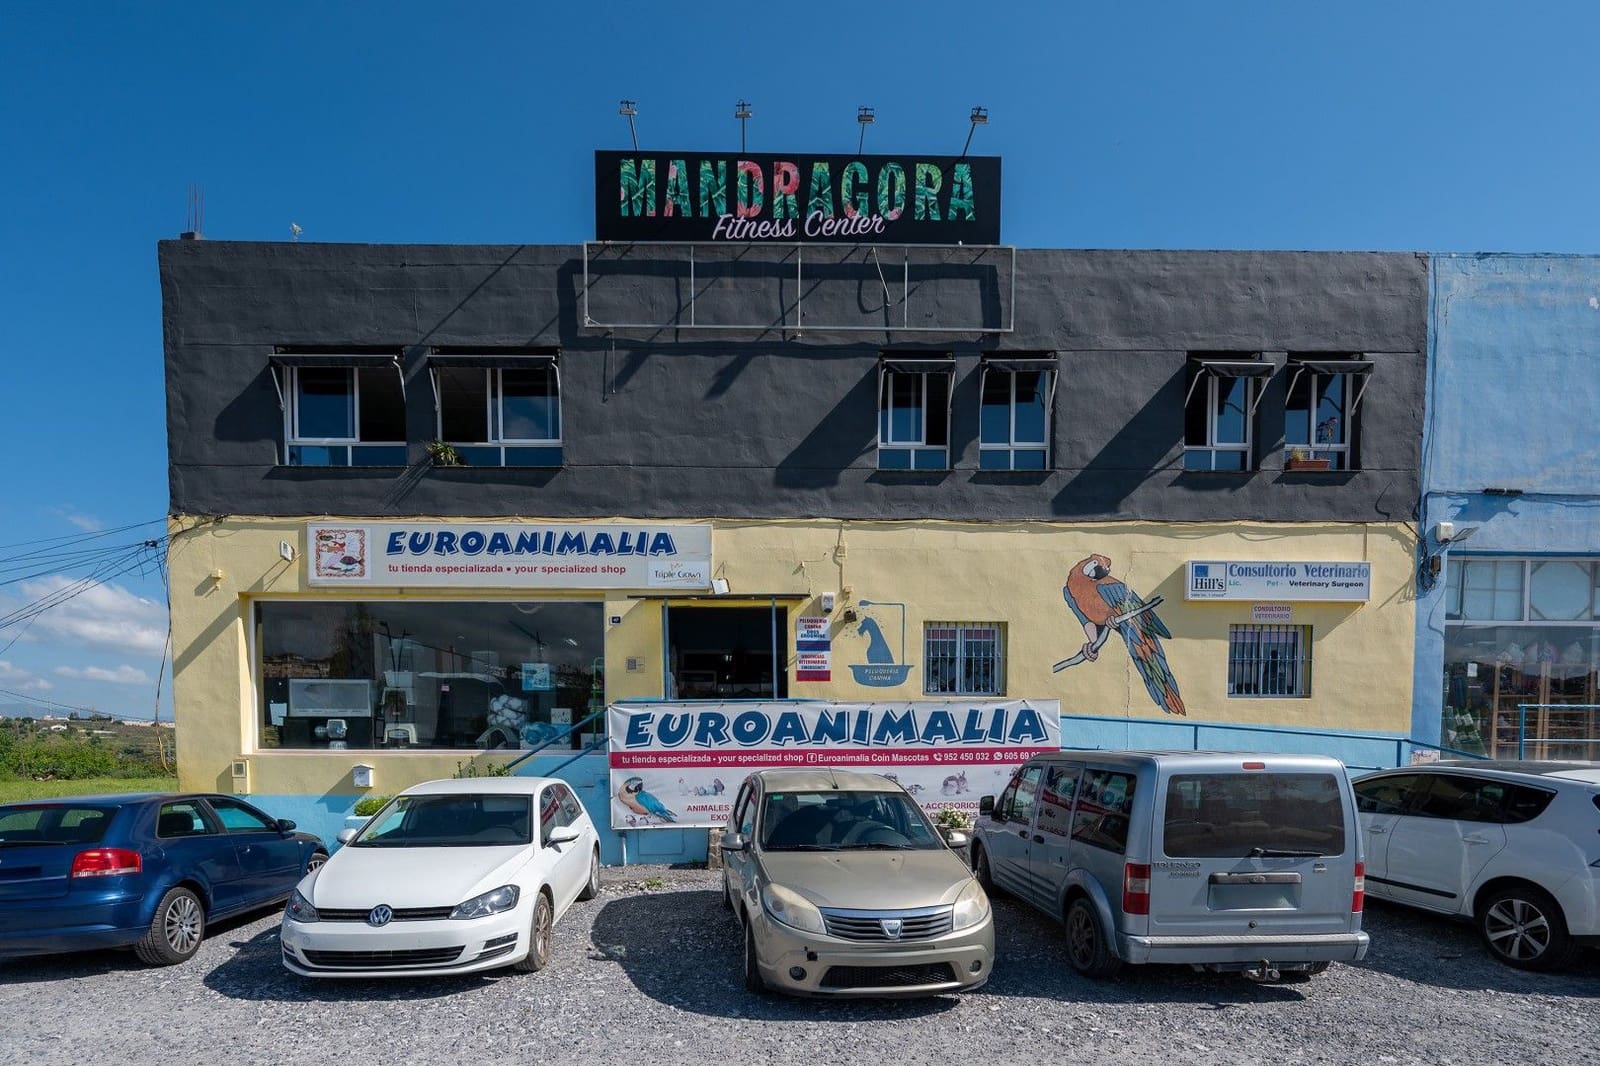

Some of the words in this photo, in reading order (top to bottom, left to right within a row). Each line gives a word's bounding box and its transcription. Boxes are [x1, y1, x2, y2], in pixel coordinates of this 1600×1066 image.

[619, 158, 976, 221] MANDRAGORA
[712, 213, 797, 240] Fitness
[804, 210, 886, 238] Center
[386, 530, 677, 556] EUROANIMALIA
[388, 564, 399, 573] tu
[401, 564, 433, 573] tienda
[435, 563, 503, 575] especializada
[515, 565, 539, 575] your
[541, 563, 598, 575] specialized
[601, 564, 626, 575] shop
[1229, 564, 1297, 578] Consultorio
[1304, 564, 1369, 578] Veterinario
[1194, 578, 1224, 590] Hill's
[1289, 580, 1329, 589] Veterinary
[1331, 580, 1364, 588] Surgeon
[625, 709, 1049, 747] EUROANIMALIA
[622, 756, 631, 764] tu
[632, 755, 657, 764] tienda
[658, 754, 711, 764] especializada
[718, 755, 736, 763] your
[738, 753, 782, 763] specialized
[784, 753, 804, 763] shop
[818, 753, 870, 762] Euroanimalia
[871, 753, 890, 762] Coin
[892, 753, 929, 762] Mascotas
[943, 752, 958, 761] 952
[959, 752, 974, 761] 450
[975, 752, 990, 761] 032
[1003, 751, 1019, 760] 605
[1020, 751, 1029, 760] 69
[686, 804, 729, 812] ANIMALES
